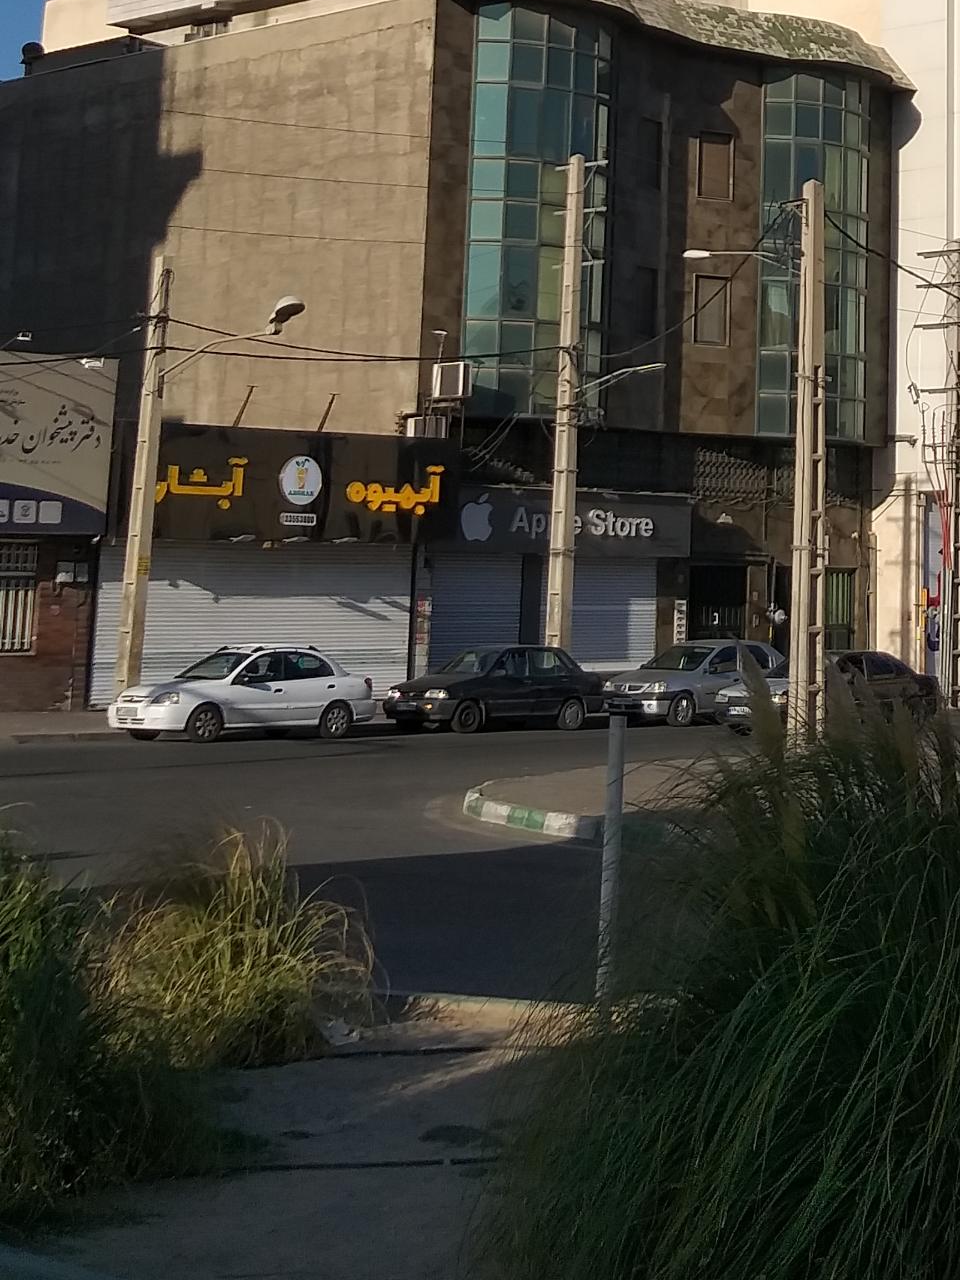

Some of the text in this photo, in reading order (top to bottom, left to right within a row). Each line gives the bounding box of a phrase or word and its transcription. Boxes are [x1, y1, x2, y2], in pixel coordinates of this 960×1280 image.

[21, 404, 78, 454] پیشخوان
[72, 415, 101, 453] دفتر
[346, 465, 445, 515] آبمیوه
[510, 506, 654, 539] Ape Store
